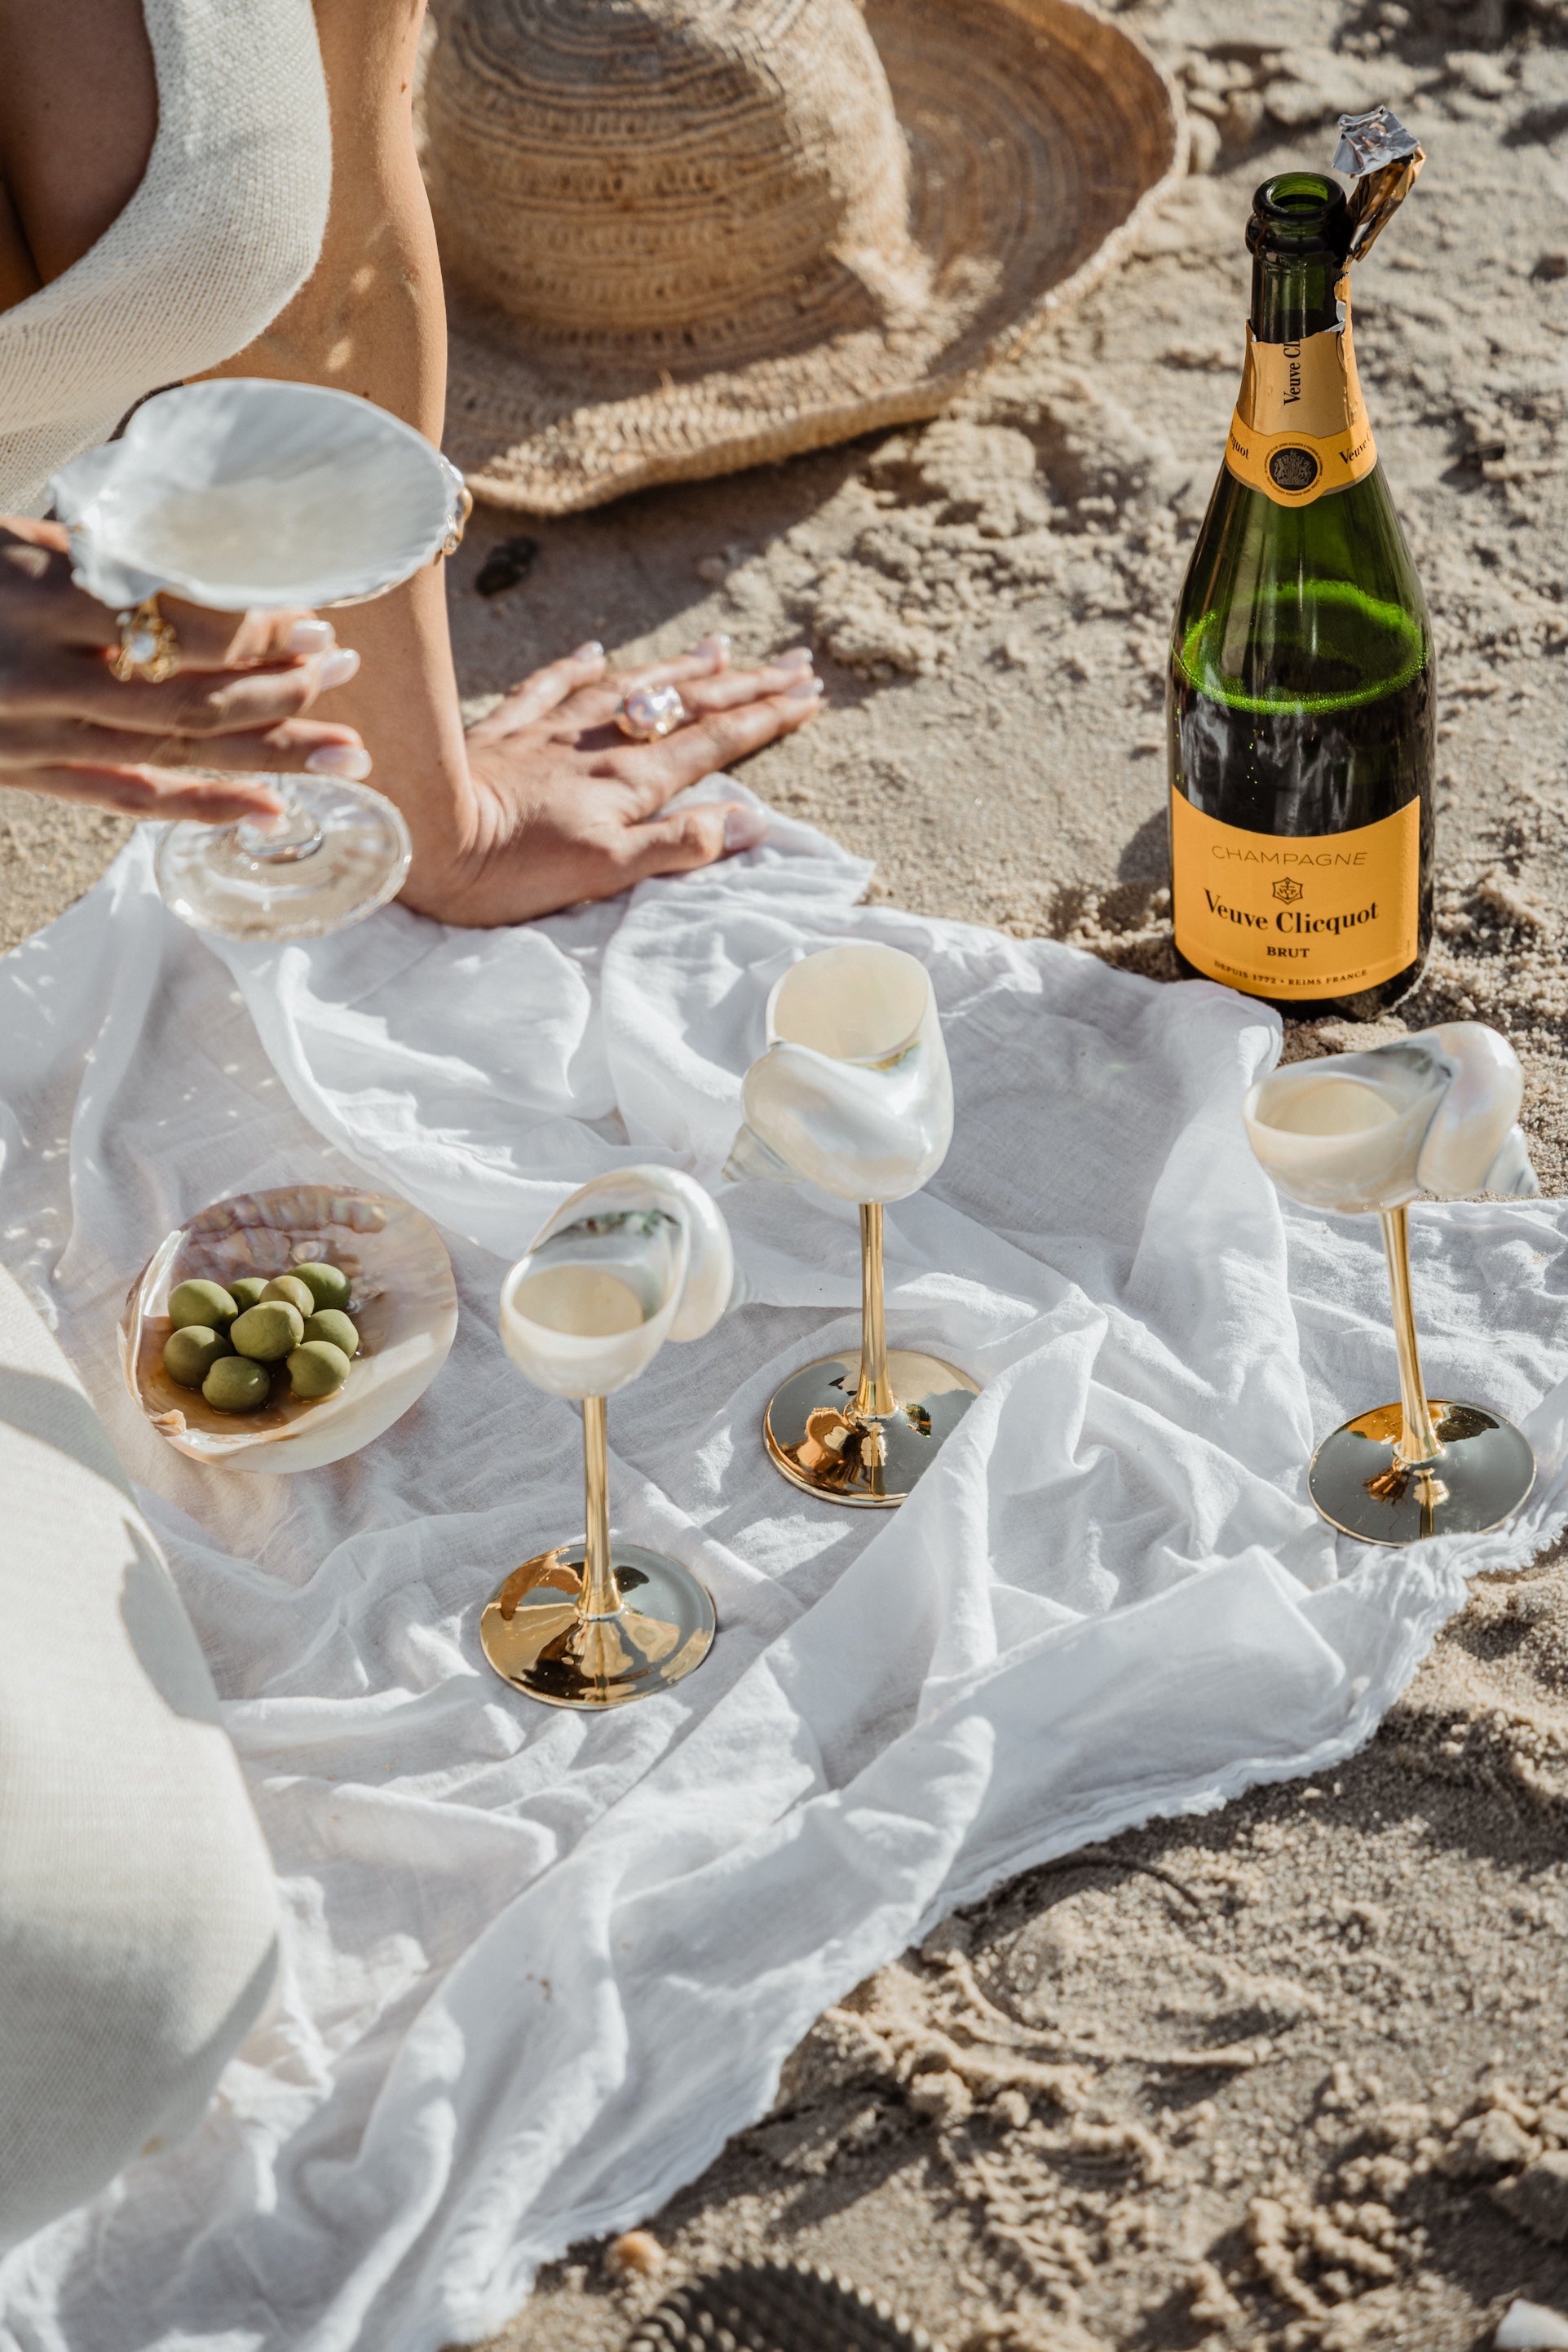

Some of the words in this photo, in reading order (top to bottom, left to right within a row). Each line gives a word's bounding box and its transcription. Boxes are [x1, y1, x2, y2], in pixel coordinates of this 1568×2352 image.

[1283, 361, 1301, 406] Veuve
[1338, 440, 1367, 464] Veuve
[1211, 845, 1368, 867] CHAMPAGNE
[1203, 887, 1269, 931] Veuve
[1276, 901, 1380, 935] Clicquot
[1266, 945, 1310, 958] BRUT
[1214, 959, 1248, 979] DEPUIS
[1252, 974, 1277, 984] 1772
[1288, 979, 1322, 987] REIMS
[1326, 968, 1368, 984] FRANCE
